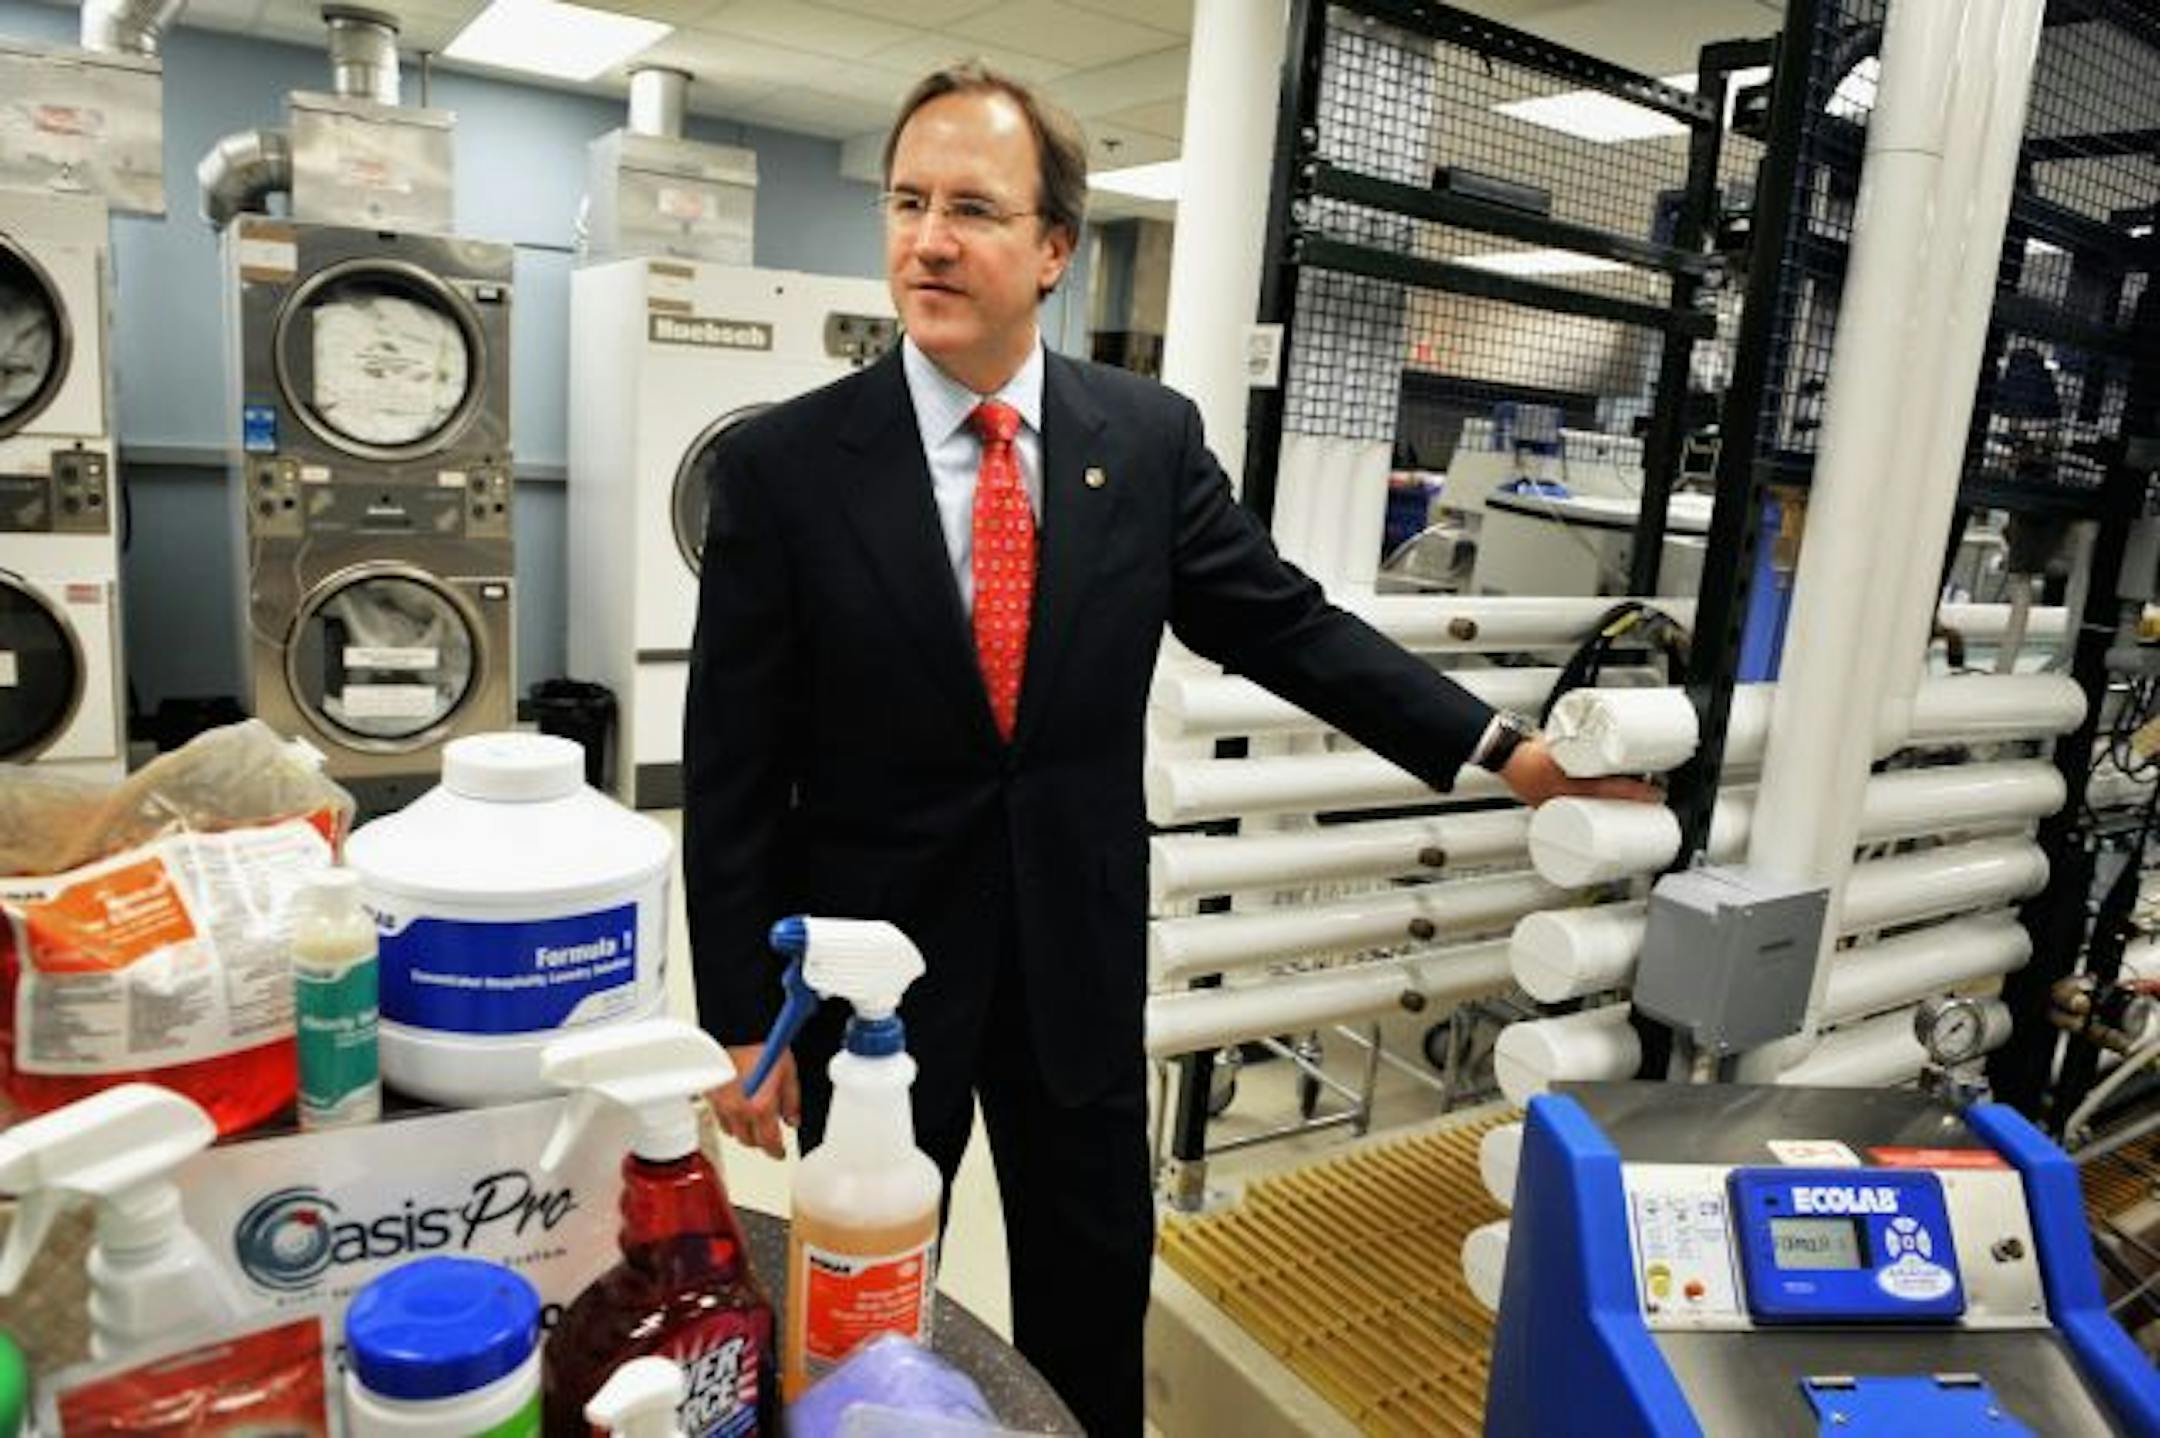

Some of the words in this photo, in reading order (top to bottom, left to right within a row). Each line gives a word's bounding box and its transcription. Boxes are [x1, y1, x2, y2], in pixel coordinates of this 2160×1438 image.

[655, 318, 767, 347] Huebsch
[534, 937, 618, 969] Formula
[622, 929, 633, 951] 1
[1790, 1187, 1899, 1214] ECOLAB
[235, 1187, 451, 1291] Oasis
[460, 1170, 578, 1249] Pro
